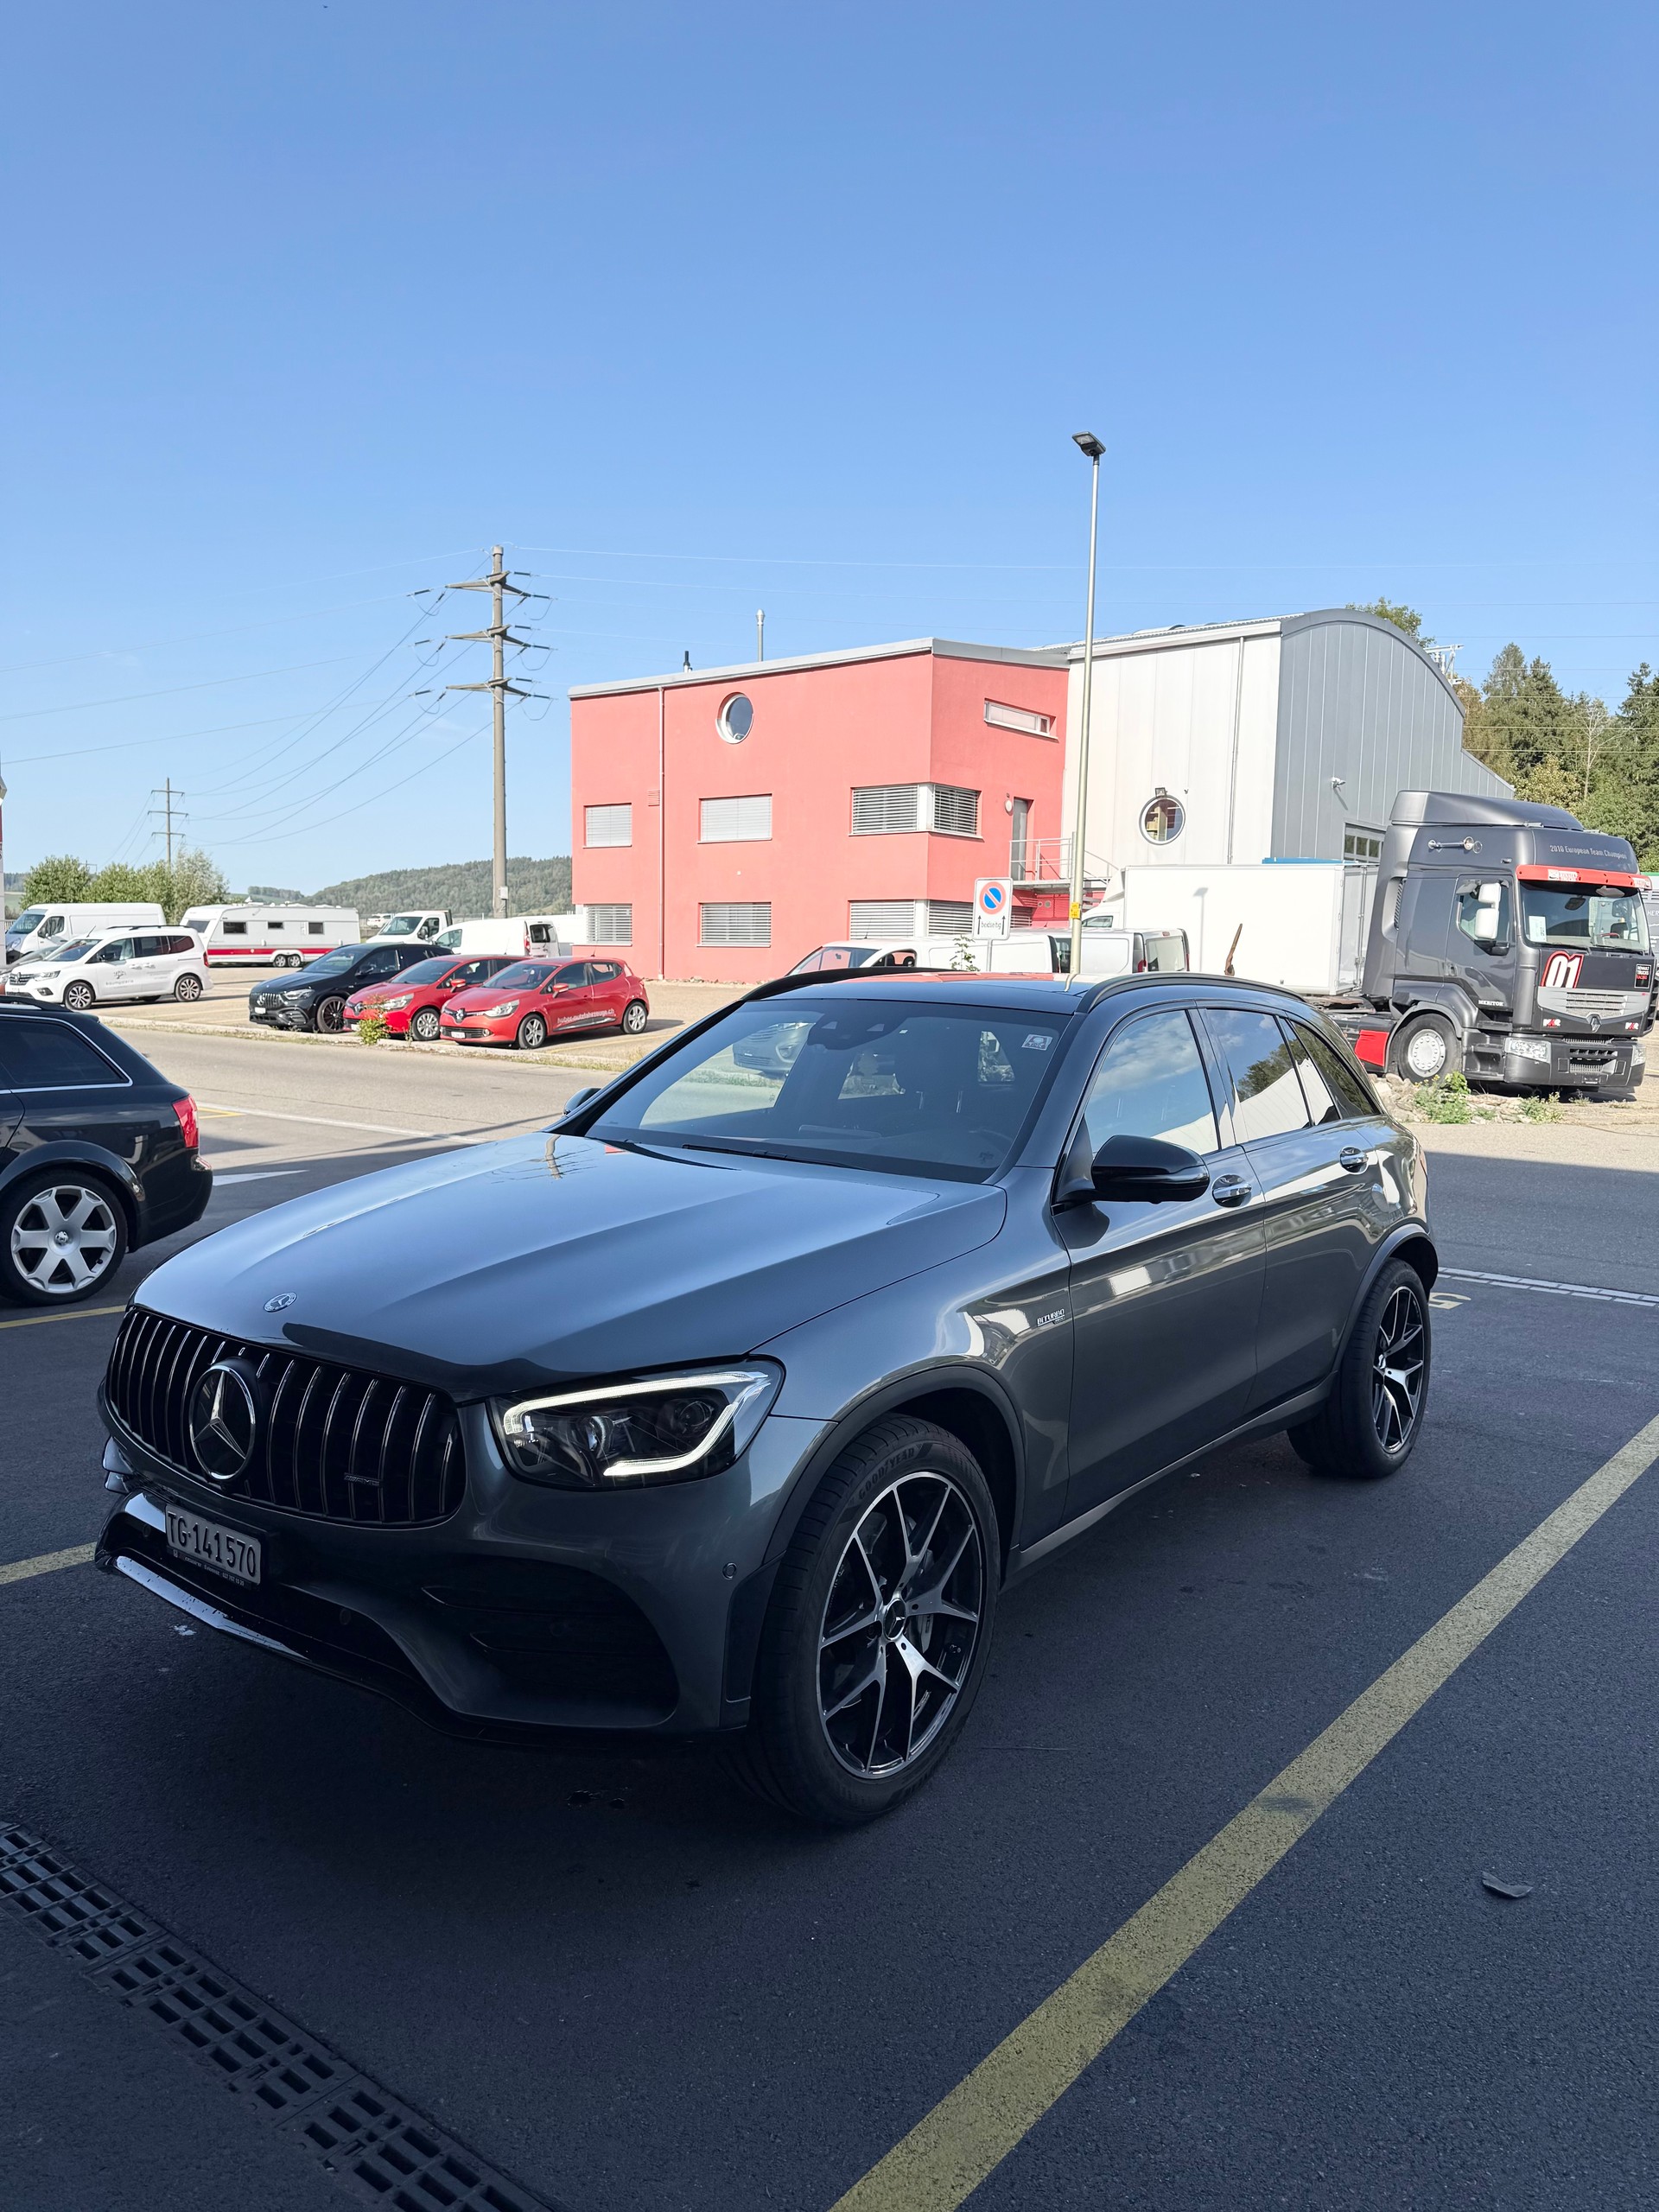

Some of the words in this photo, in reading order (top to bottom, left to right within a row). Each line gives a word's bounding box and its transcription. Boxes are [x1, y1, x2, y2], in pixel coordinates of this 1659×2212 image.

[1565, 846, 1590, 855] European
[1590, 848, 1604, 856] Team
[1542, 951, 1583, 988] 01
[858, 1447, 915, 1500] GOODYEAR
